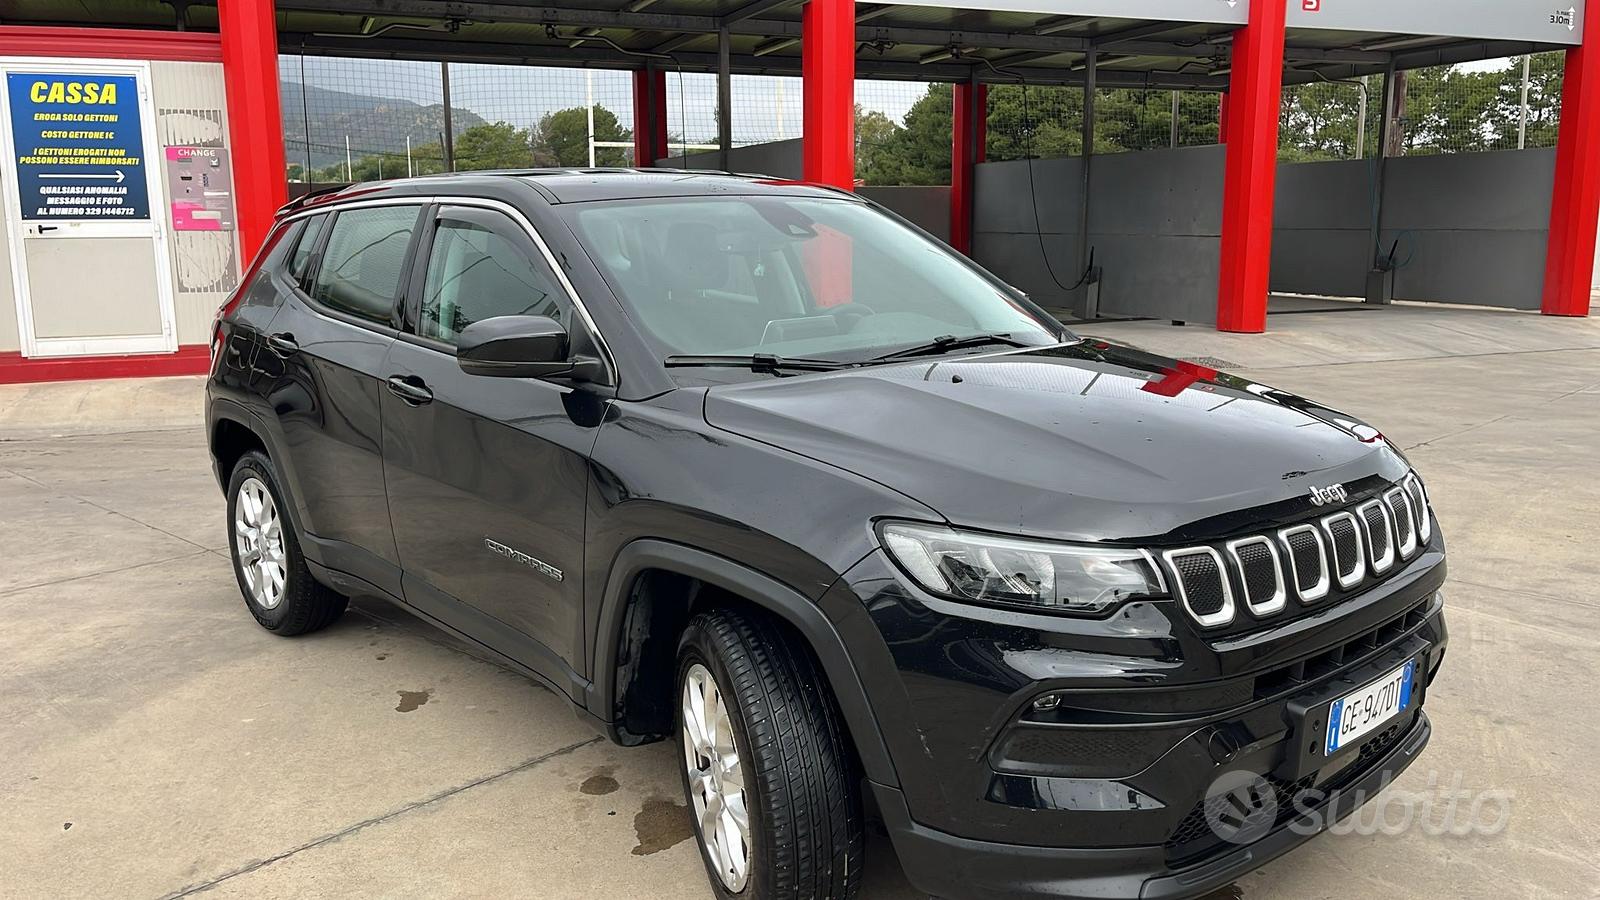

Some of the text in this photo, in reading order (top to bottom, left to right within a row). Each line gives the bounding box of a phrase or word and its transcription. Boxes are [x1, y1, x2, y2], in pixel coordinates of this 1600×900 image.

[30, 81, 117, 105] CASSA
[34, 113, 118, 122] EROGA SOLO GETTONI
[69, 131, 104, 139] GETTONE
[38, 148, 72, 156] GETTONI
[73, 148, 107, 156] EROGATI
[178, 149, 216, 157] CHANGE
[59, 157, 89, 165] ESSERE
[90, 157, 139, 165] RIMBORSATI
[40, 187, 128, 195] QUALSIASI ANOMALIA
[46, 197, 95, 205] MESSAGGIO
[102, 197, 123, 205] FOTO
[1309, 483, 1348, 507] Jeep
[484, 538, 564, 582] COMPASS
